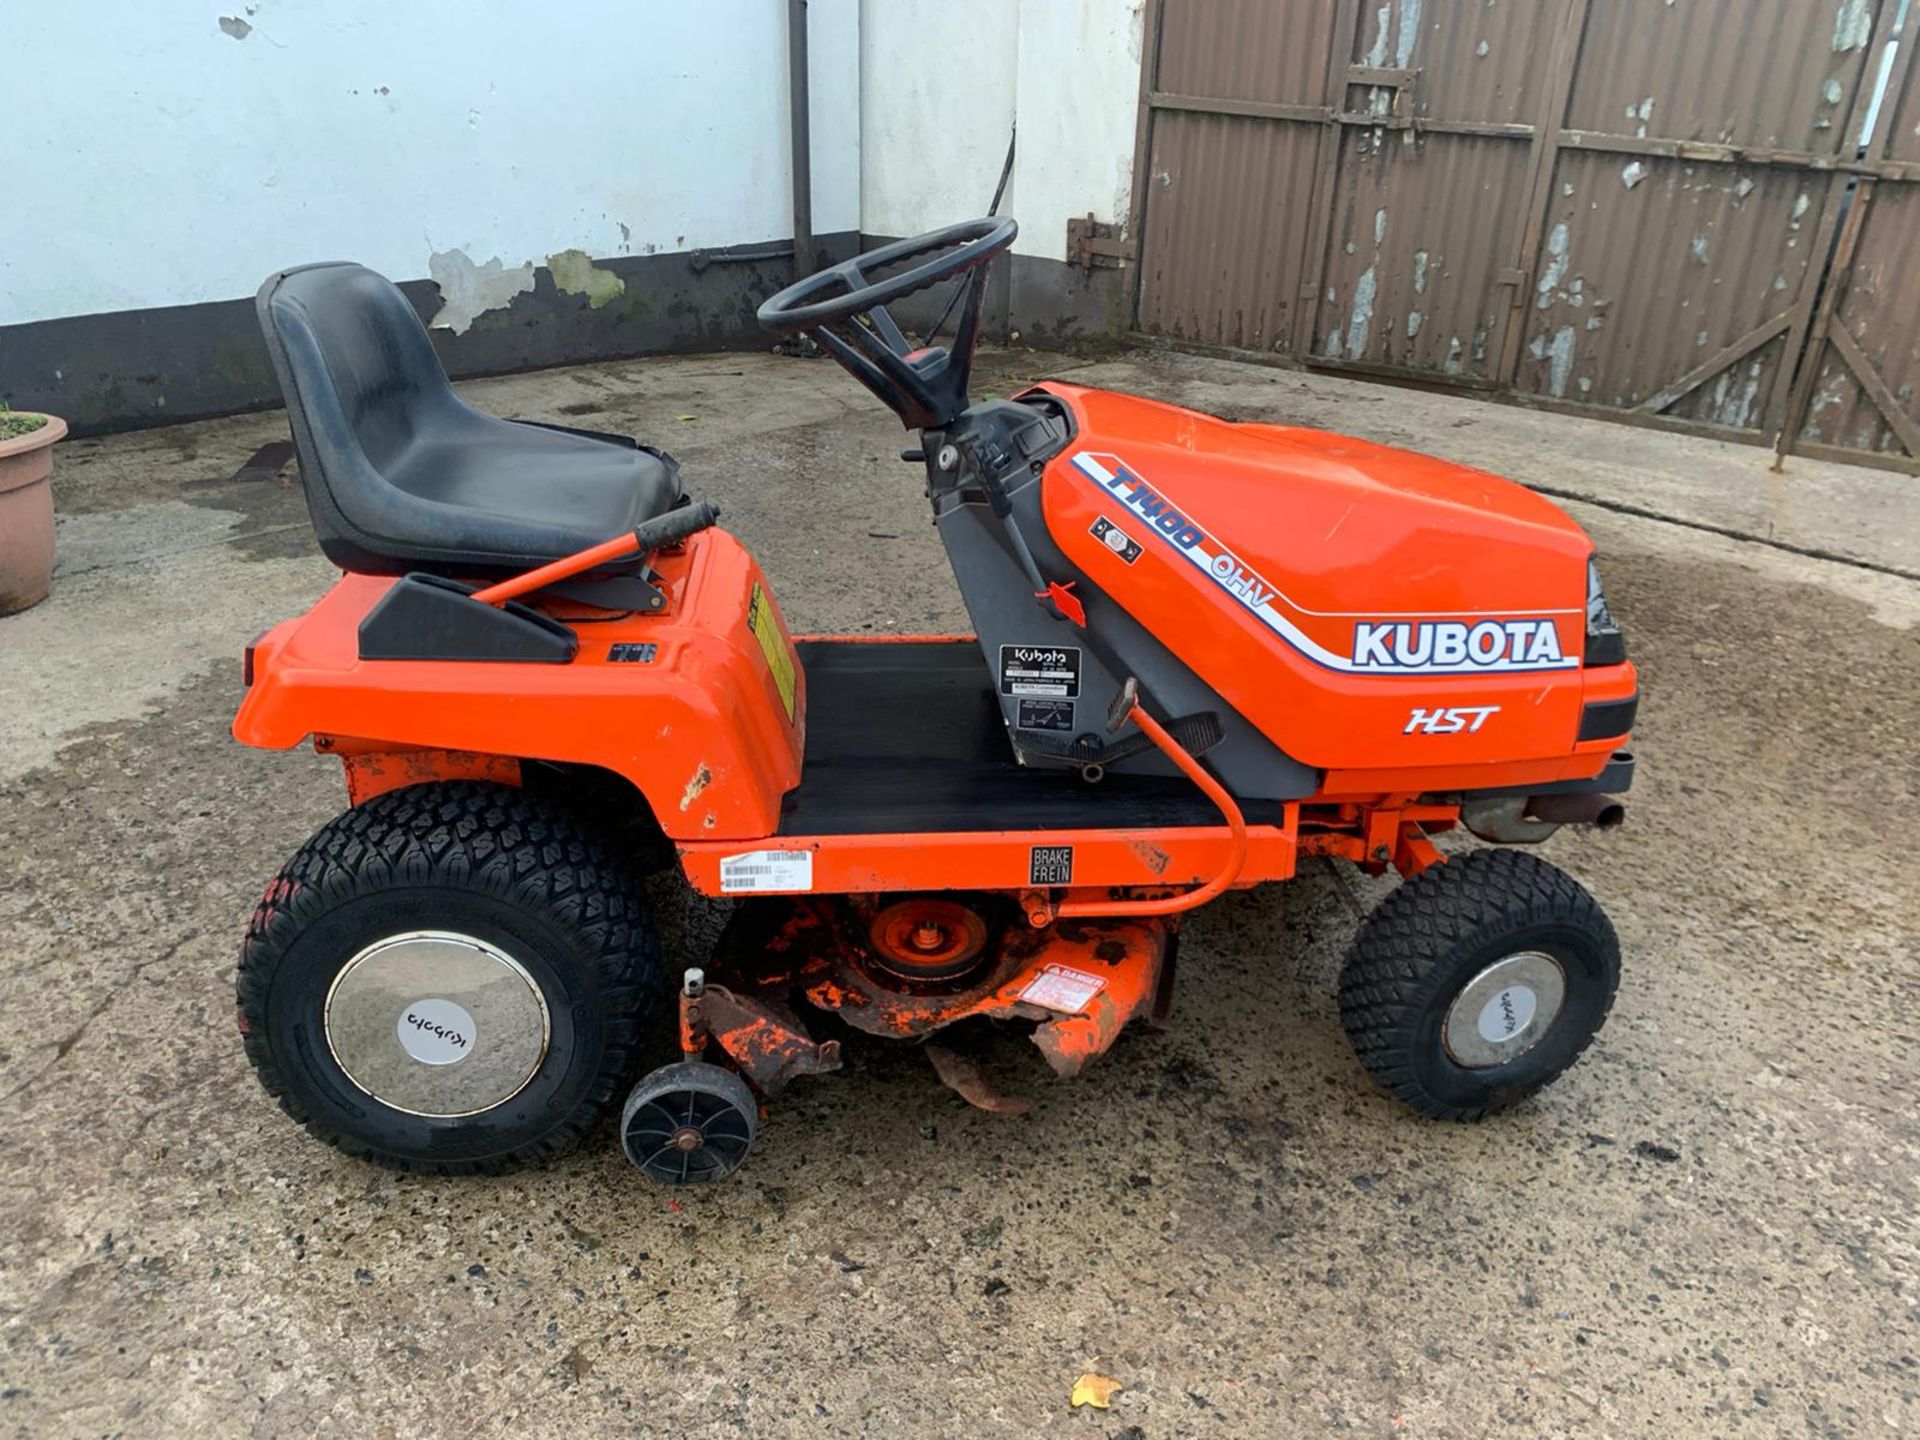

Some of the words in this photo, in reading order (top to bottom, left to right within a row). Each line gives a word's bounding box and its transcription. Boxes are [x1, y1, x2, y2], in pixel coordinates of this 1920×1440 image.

[1107, 467, 1204, 550] T1400
[1211, 554, 1275, 608] OHV
[1015, 649, 1066, 662] Kubota
[1352, 620, 1564, 668] KUBOTA
[1402, 706, 1501, 734] HST
[1034, 849, 1070, 865] BRAKE
[1033, 866, 1070, 882] FREIN
[407, 1013, 466, 1048] Kubota
